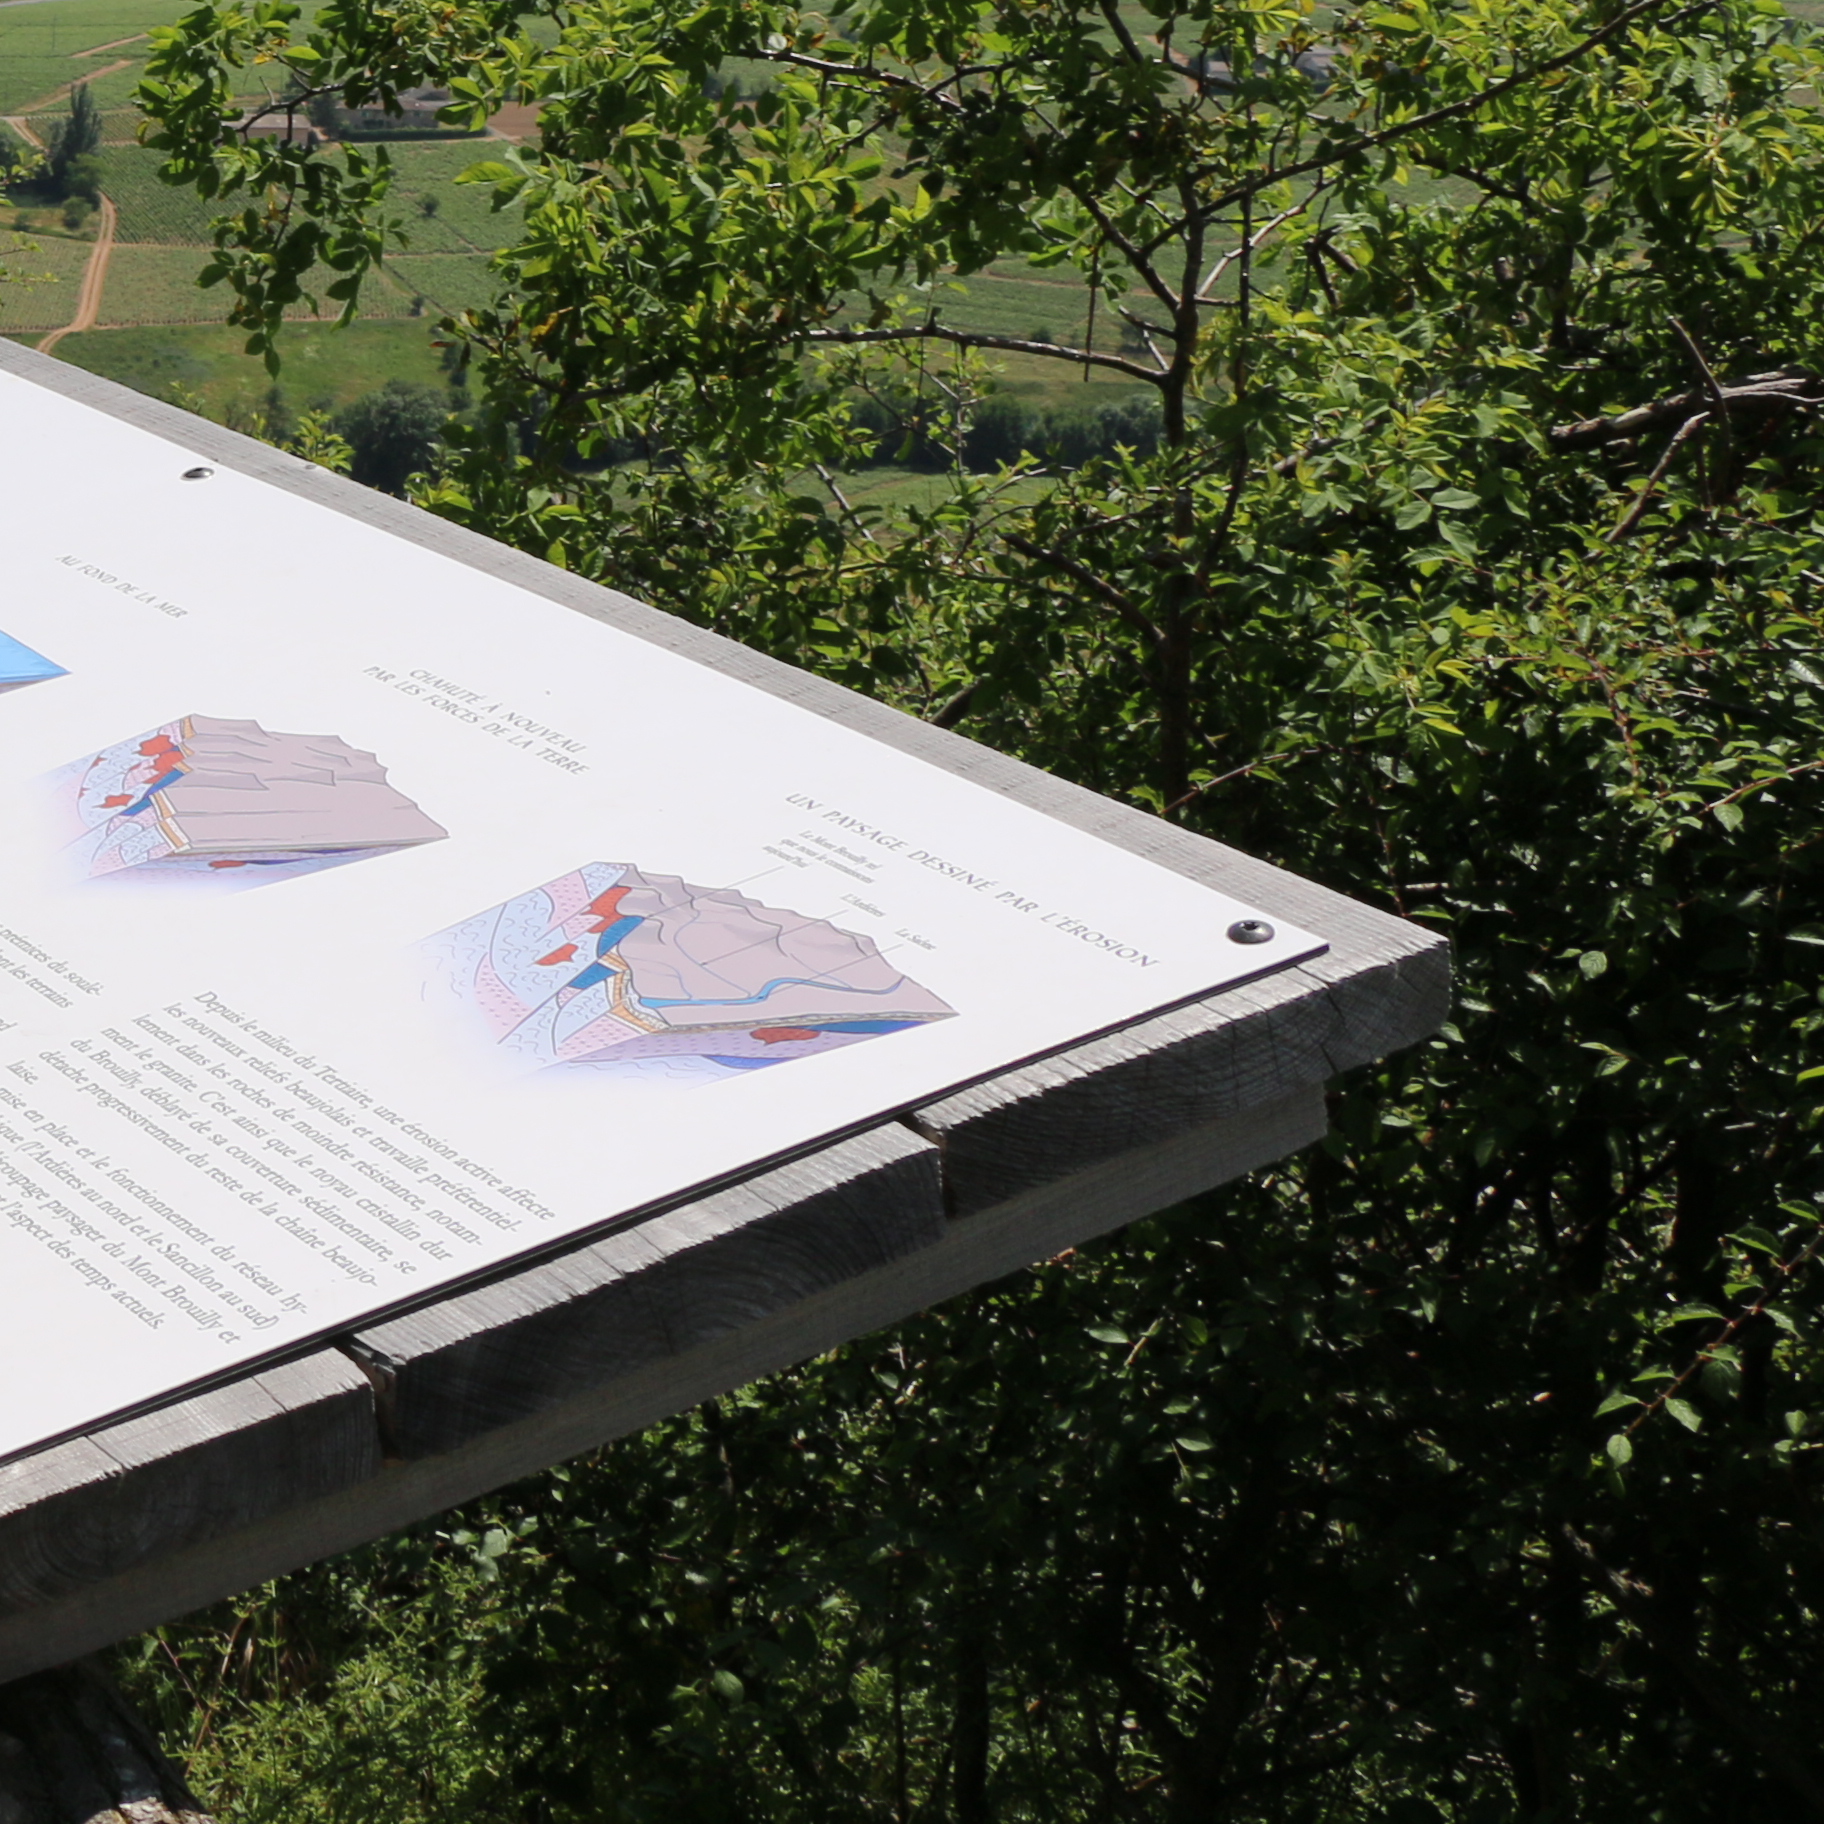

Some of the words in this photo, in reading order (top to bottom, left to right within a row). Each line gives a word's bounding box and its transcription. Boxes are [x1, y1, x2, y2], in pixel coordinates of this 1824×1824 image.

[55, 555, 81, 566] AU
[77, 565, 117, 583] FOND
[114, 583, 139, 594] DE
[134, 592, 157, 604] LA
[154, 602, 188, 618] MER
[363, 666, 396, 682] PAR
[394, 681, 426, 695] LES
[422, 695, 484, 723] FORCES
[482, 723, 511, 736] DE
[507, 735, 533, 749] LA
[536, 748, 590, 774] TERRE
[410, 670, 487, 704] CHAHUTÉ
[481, 703, 503, 713] À
[500, 712, 586, 753] NOUVEAU
[786, 794, 823, 810] UN
[822, 811, 908, 851] PAYSAGE
[907, 851, 998, 891] DESSINÉ
[995, 891, 1038, 912] PAR
[1041, 913, 1159, 967] L'ÉROSION
[100, 1028, 140, 1051] ment
[134, 1048, 153, 1060] le
[6, 1060, 38, 1084] laise.
[142, 1061, 197, 1092] granite.
[24, 1110, 44, 1123] en
[162, 1003, 187, 1018] les
[181, 1018, 247, 1057] nouveaux
[243, 1057, 292, 1083] reliefs
[284, 1080, 355, 1126] beaujolais
[352, 1127, 373, 1138] et
[369, 1137, 428, 1174] travaille
[417, 1174, 522, 1232] préférentiel-
[193, 991, 245, 1023] Depuis
[238, 1020, 257, 1032] le
[252, 1031, 297, 1057] milieu
[293, 1056, 317, 1070] du
[313, 1065, 373, 1109] Tertiaire,
[373, 1106, 404, 1125] une
[400, 1123, 458, 1159] érosion
[454, 1159, 502, 1186] active
[497, 1186, 555, 1220] affecte
[199, 1091, 237, 1116] C'est
[33, 1123, 79, 1147] place
[131, 1014, 181, 1046] lement
[176, 1045, 211, 1066] dans
[206, 1063, 231, 1079] les
[226, 1079, 275, 1108] roches
[272, 1108, 295, 1121] de
[291, 1121, 355, 1160] moindre
[351, 1161, 426, 1211] résistance,
[425, 1210, 482, 1245] notam-
[232, 1116, 275, 1138] ainsi
[71, 1039, 92, 1053] du
[88, 1050, 143, 1089] Brouilly,
[140, 1087, 198, 1121] déblayé
[189, 1120, 212, 1134] de
[207, 1134, 228, 1146] sa
[225, 1146, 302, 1196] couverture
[298, 1197, 393, 1262] sédimentaire,
[393, 1261, 417, 1274] se
[76, 1148, 96, 1159] et
[90, 1156, 110, 1169] le
[262, 1139, 297, 1157] que
[293, 1154, 313, 1167] le
[39, 1051, 89, 1084] détache
[76, 1083, 191, 1154] progressivement
[185, 1153, 209, 1168] du
[204, 1168, 243, 1191] reste
[240, 1191, 264, 1205] de
[258, 1202, 278, 1216] la
[275, 1216, 325, 1249] chaîne
[321, 1245, 377, 1286] beaujo-
[309, 1168, 358, 1198] noyau
[105, 1169, 215, 1245] fonctionnement
[356, 1199, 421, 1241] cristallin
[14, 1142, 86, 1189] (l'Ardières
[80, 1189, 103, 1202] au
[96, 1201, 142, 1226] nord
[130, 1225, 150, 1236] et
[142, 1232, 163, 1246] le
[157, 1243, 223, 1292] Sancillon
[218, 1291, 243, 1306] au
[237, 1305, 279, 1329] sud)
[419, 1241, 453, 1260] dur
[0, 1202, 53, 1241] l'aspect
[47, 1240, 75, 1258] des
[70, 1258, 116, 1290] temps
[111, 1291, 165, 1329] actuels.
[211, 1246, 235, 1261] du
[37, 1200, 106, 1242] paysager
[101, 1242, 125, 1258] du
[120, 1255, 166, 1288] Mont
[161, 1285, 223, 1330] Brouilly
[219, 1331, 240, 1344] et
[232, 1262, 283, 1296] réseau
[279, 1293, 307, 1314] hy-
